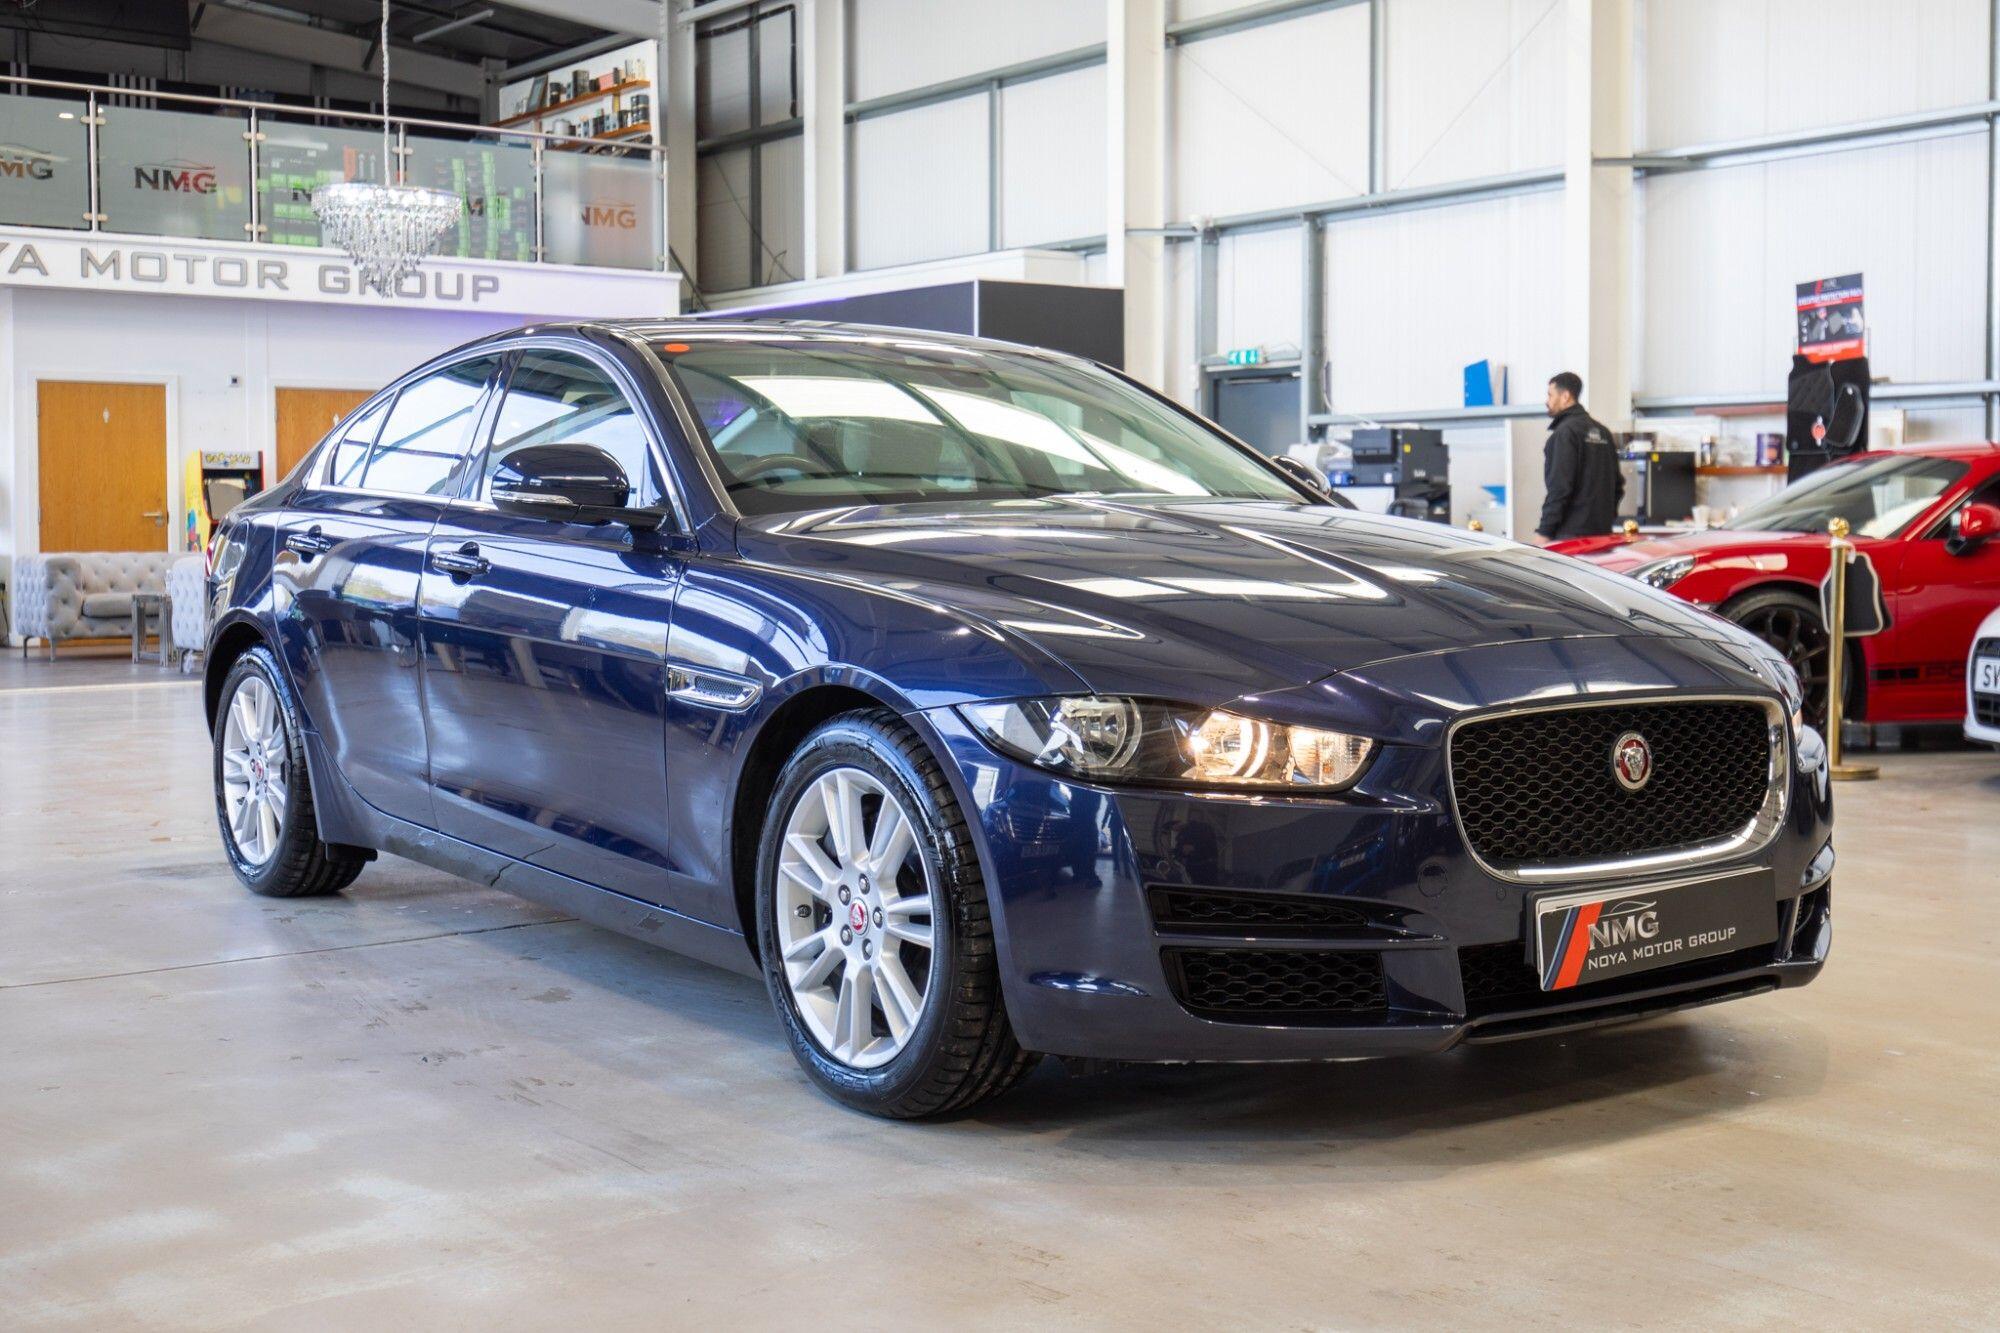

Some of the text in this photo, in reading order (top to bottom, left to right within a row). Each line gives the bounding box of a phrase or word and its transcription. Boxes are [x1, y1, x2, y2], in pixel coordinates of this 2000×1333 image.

[134, 167, 217, 194] NMG
[80, 247, 289, 291] MOTOR
[1587, 911, 1659, 950] NMG
[1588, 927, 1736, 970] NOYA MOTOR GROUP
